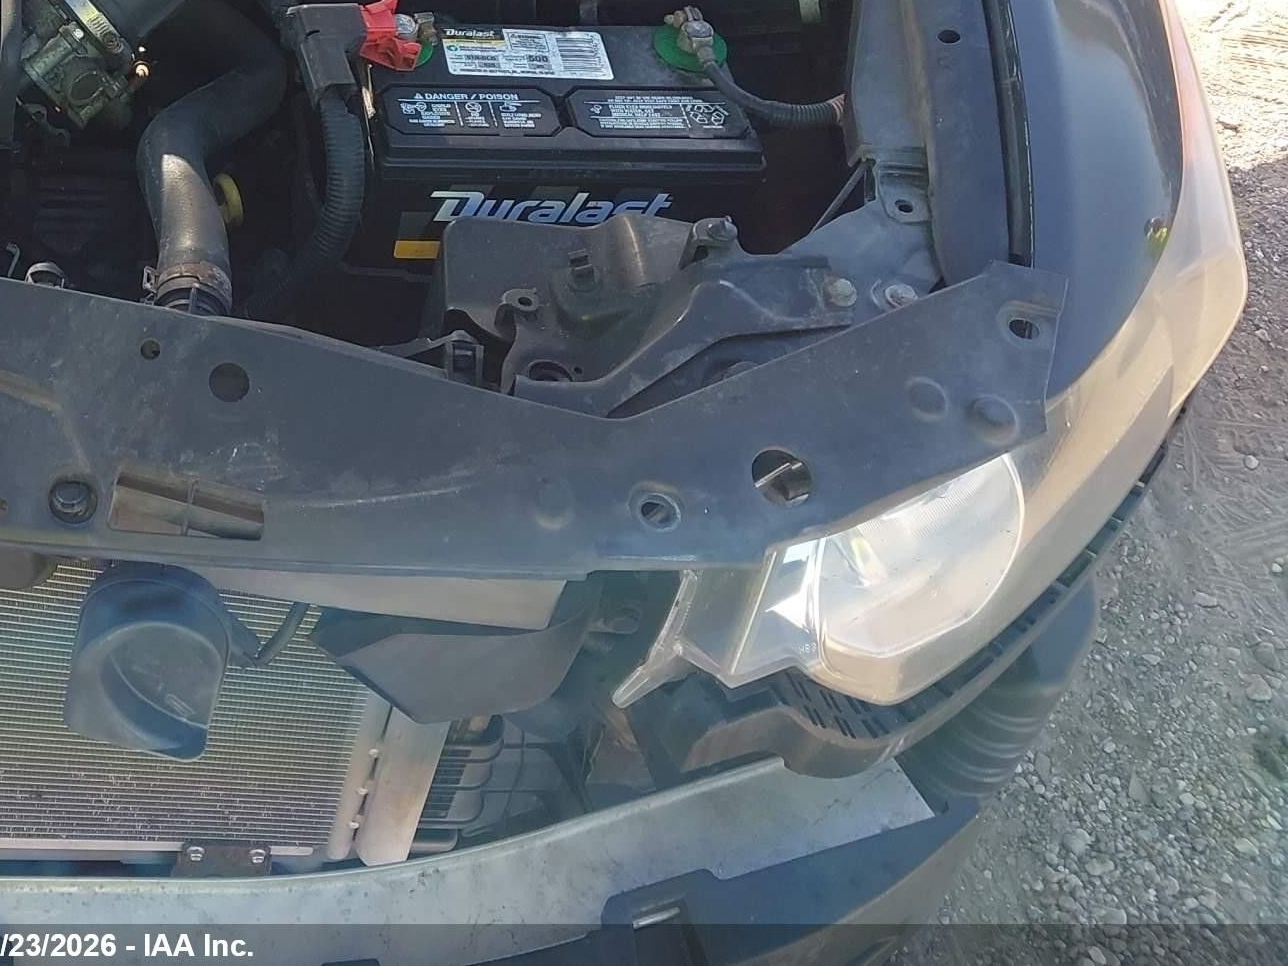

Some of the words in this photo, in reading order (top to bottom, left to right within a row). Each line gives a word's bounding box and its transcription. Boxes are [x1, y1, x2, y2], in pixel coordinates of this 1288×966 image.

[443, 28, 495, 38] Duralast
[528, 55, 549, 63] 500
[424, 93, 469, 101] DANGER
[479, 93, 519, 102] POISON
[430, 191, 674, 223] Duralast
